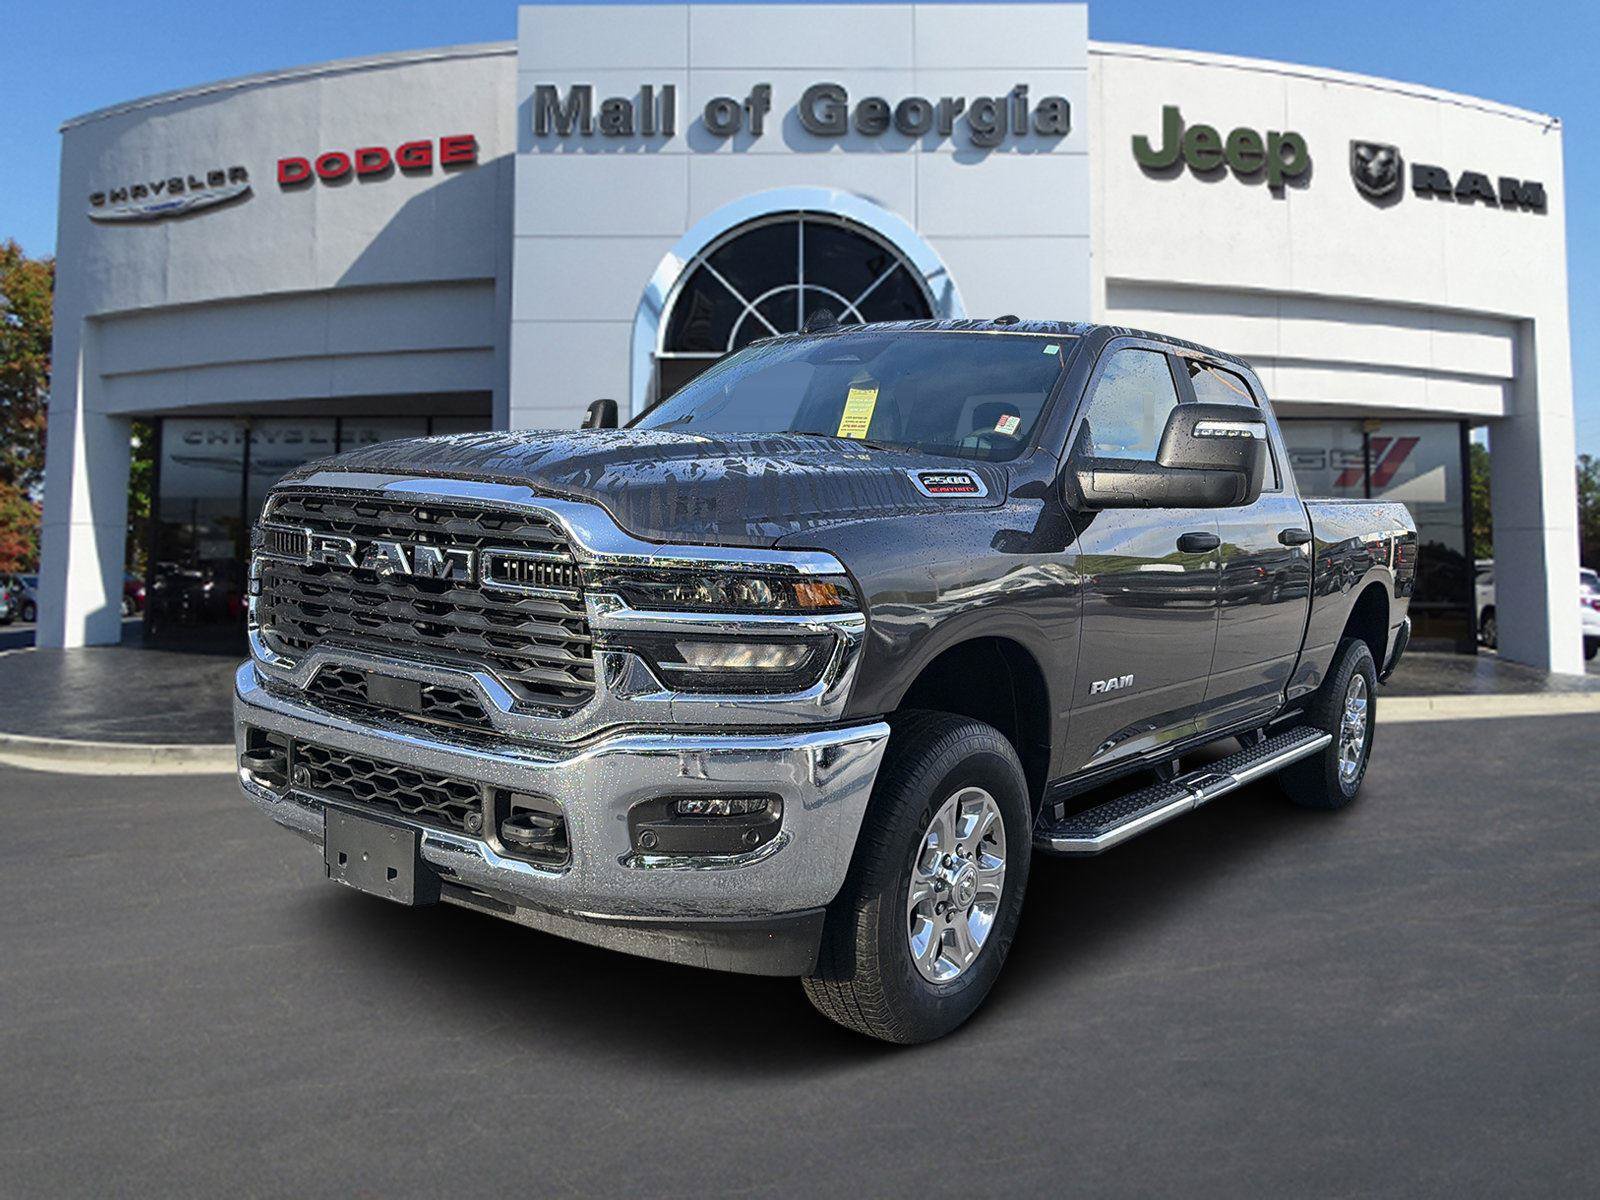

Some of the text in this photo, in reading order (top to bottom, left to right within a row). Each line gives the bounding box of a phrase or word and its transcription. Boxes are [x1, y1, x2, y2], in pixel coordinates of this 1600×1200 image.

[534, 82, 1072, 148] Mall of Georgia
[277, 134, 477, 184] DODGE
[1132, 105, 1309, 188] Jeep
[89, 165, 249, 206] CHRYSLER
[1411, 162, 1546, 211] RAM
[923, 476, 971, 485] 2500
[307, 533, 475, 582] RAM
[1090, 674, 1134, 695] RAM
